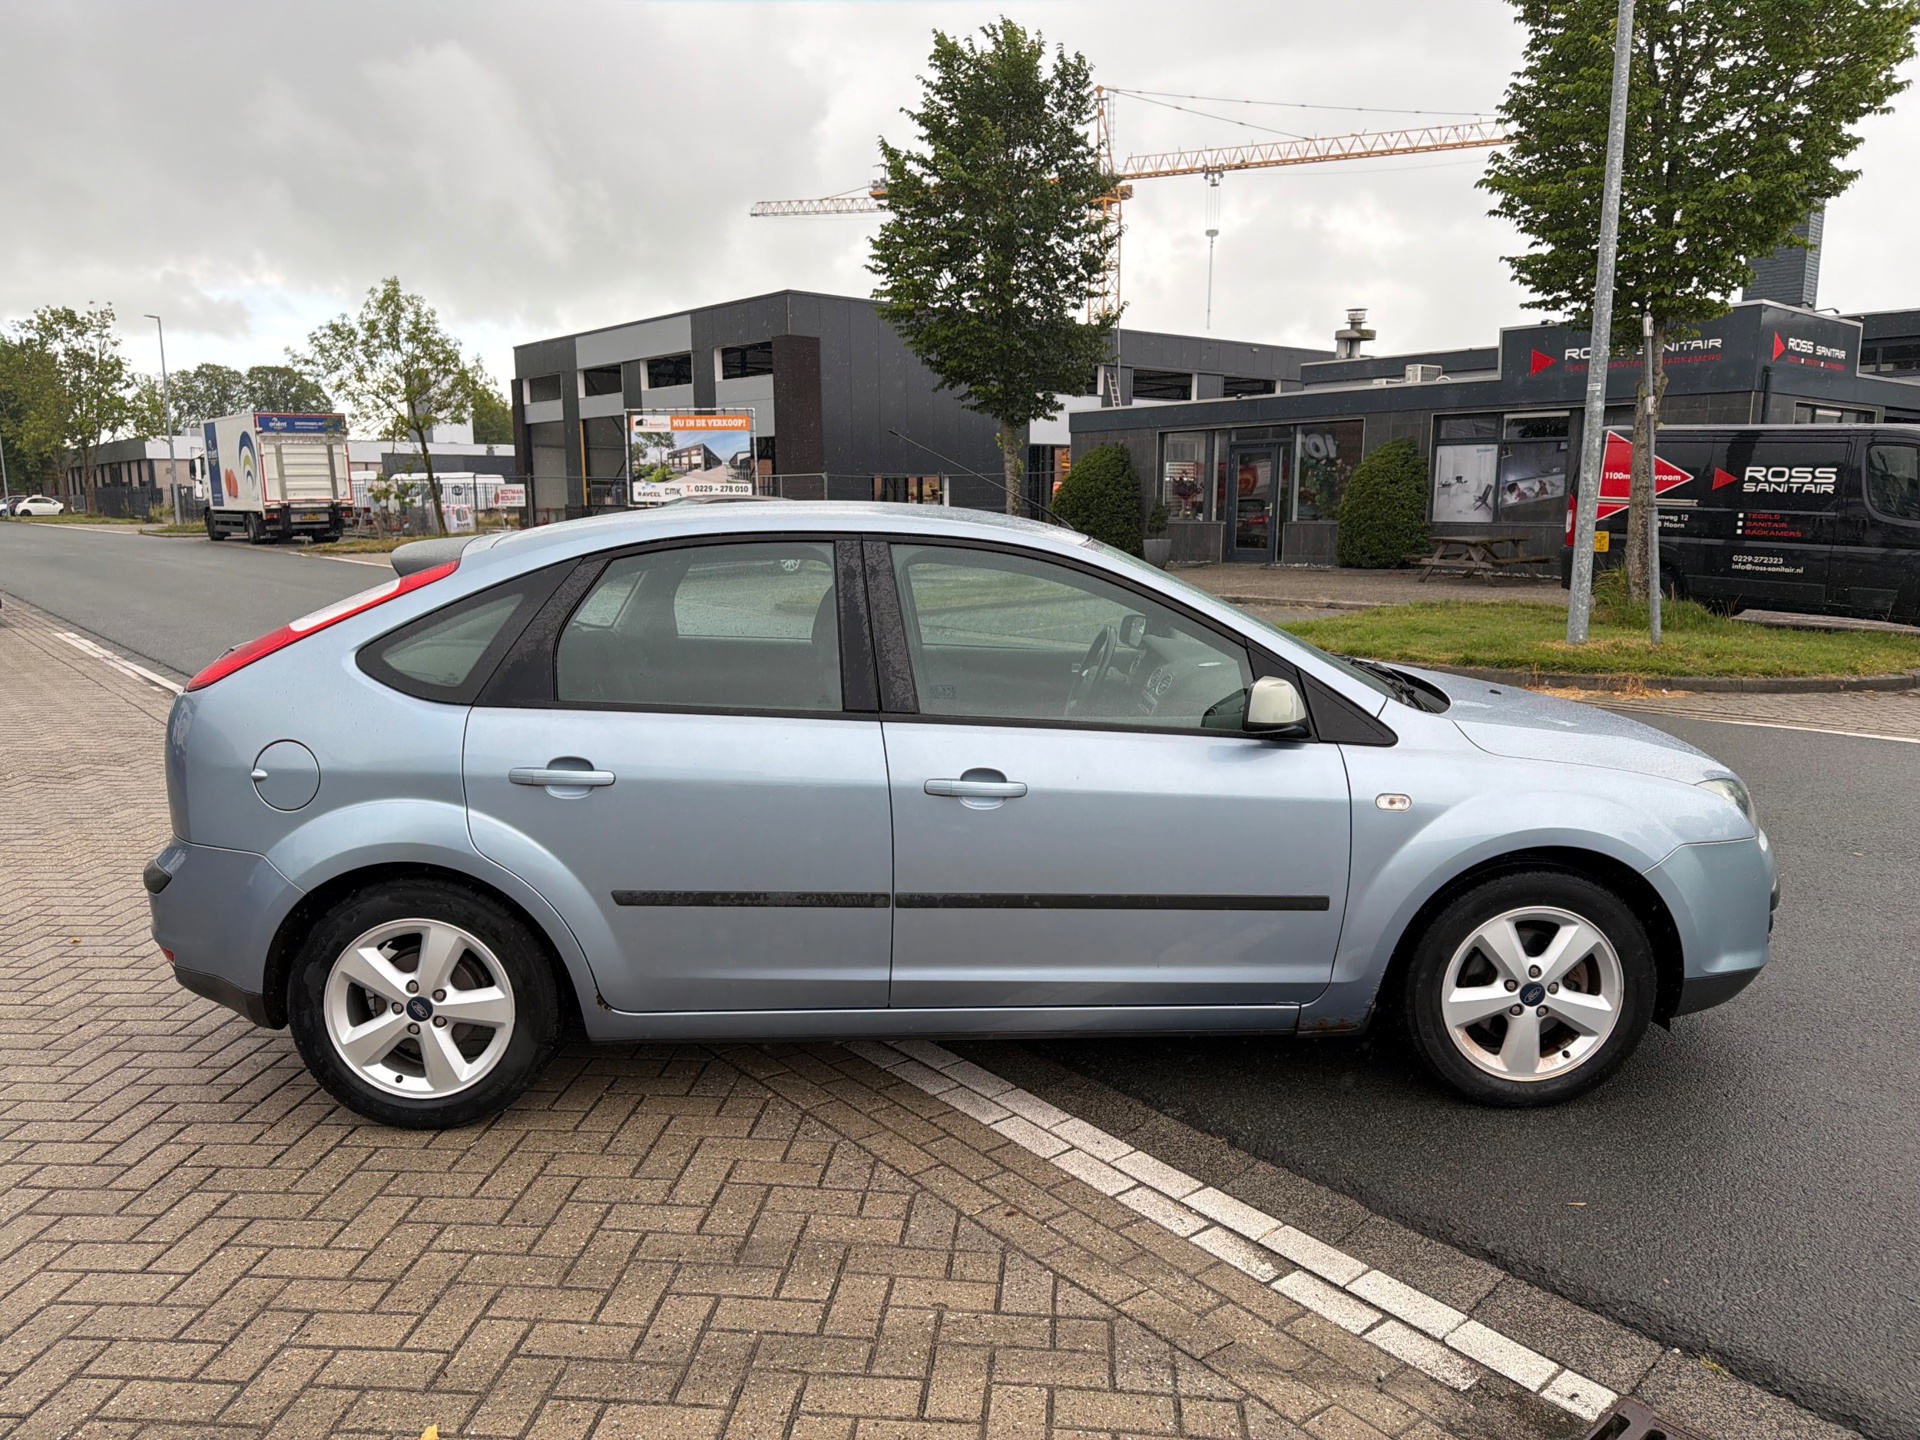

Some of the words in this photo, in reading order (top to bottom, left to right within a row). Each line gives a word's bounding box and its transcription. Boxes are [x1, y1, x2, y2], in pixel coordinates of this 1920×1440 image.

[1788, 337, 1814, 353] ROSS
[1815, 345, 1846, 360] SANITAIR
[673, 418, 684, 427] NU
[686, 418, 695, 427] IN
[696, 418, 706, 427] DE
[707, 418, 746, 427] VERKOOP!
[1744, 466, 1837, 483] ROSS
[694, 485, 713, 493] 0229
[720, 485, 734, 493] 278
[735, 485, 749, 493] 010
[1742, 483, 1835, 494] SANITAIR
[1746, 521, 1788, 529] SANITAIR
[1744, 529, 1802, 538] BADKAMERS
[1732, 554, 1784, 564] 0229-272323
[1731, 563, 1804, 574] info@ross-sanitair.nl
